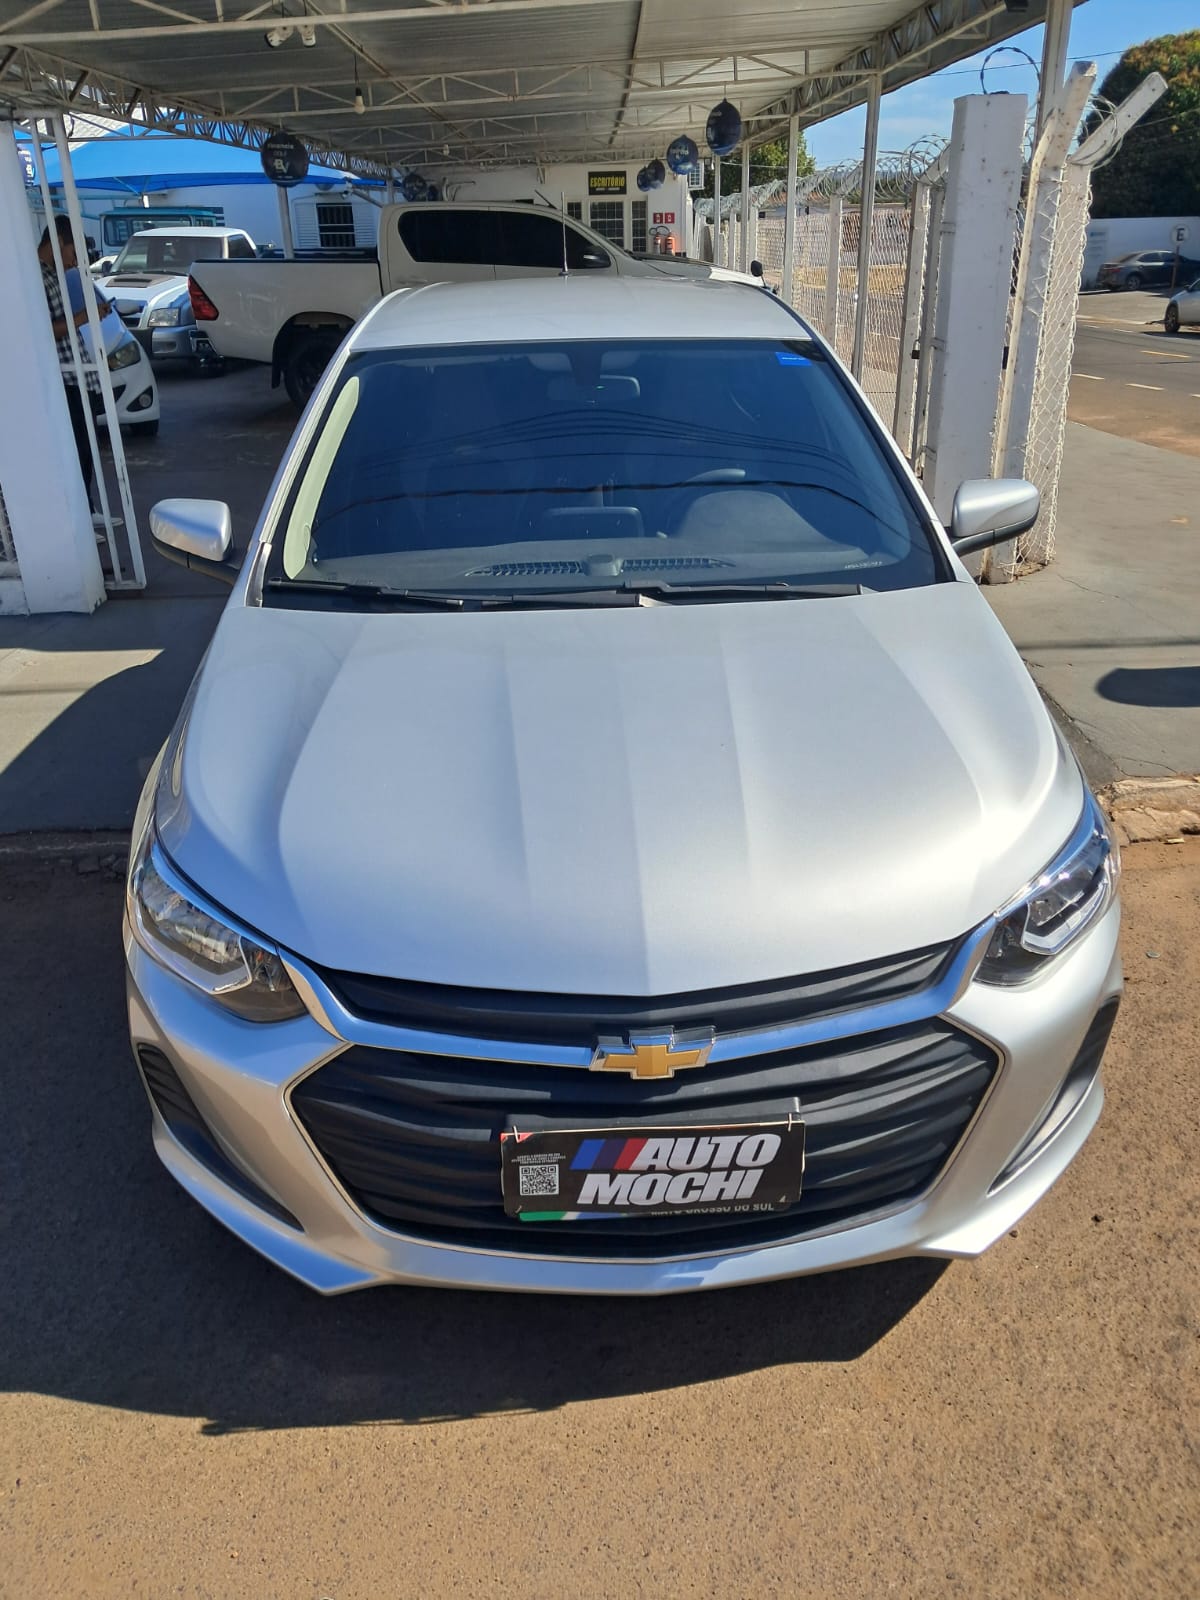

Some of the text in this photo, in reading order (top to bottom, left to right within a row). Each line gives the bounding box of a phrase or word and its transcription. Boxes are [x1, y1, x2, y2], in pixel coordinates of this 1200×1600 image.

[1176, 228, 1185, 241] E
[628, 1133, 781, 1171] AUTO
[576, 1169, 764, 1206] MOCHI
[753, 1203, 775, 1212] SUL
